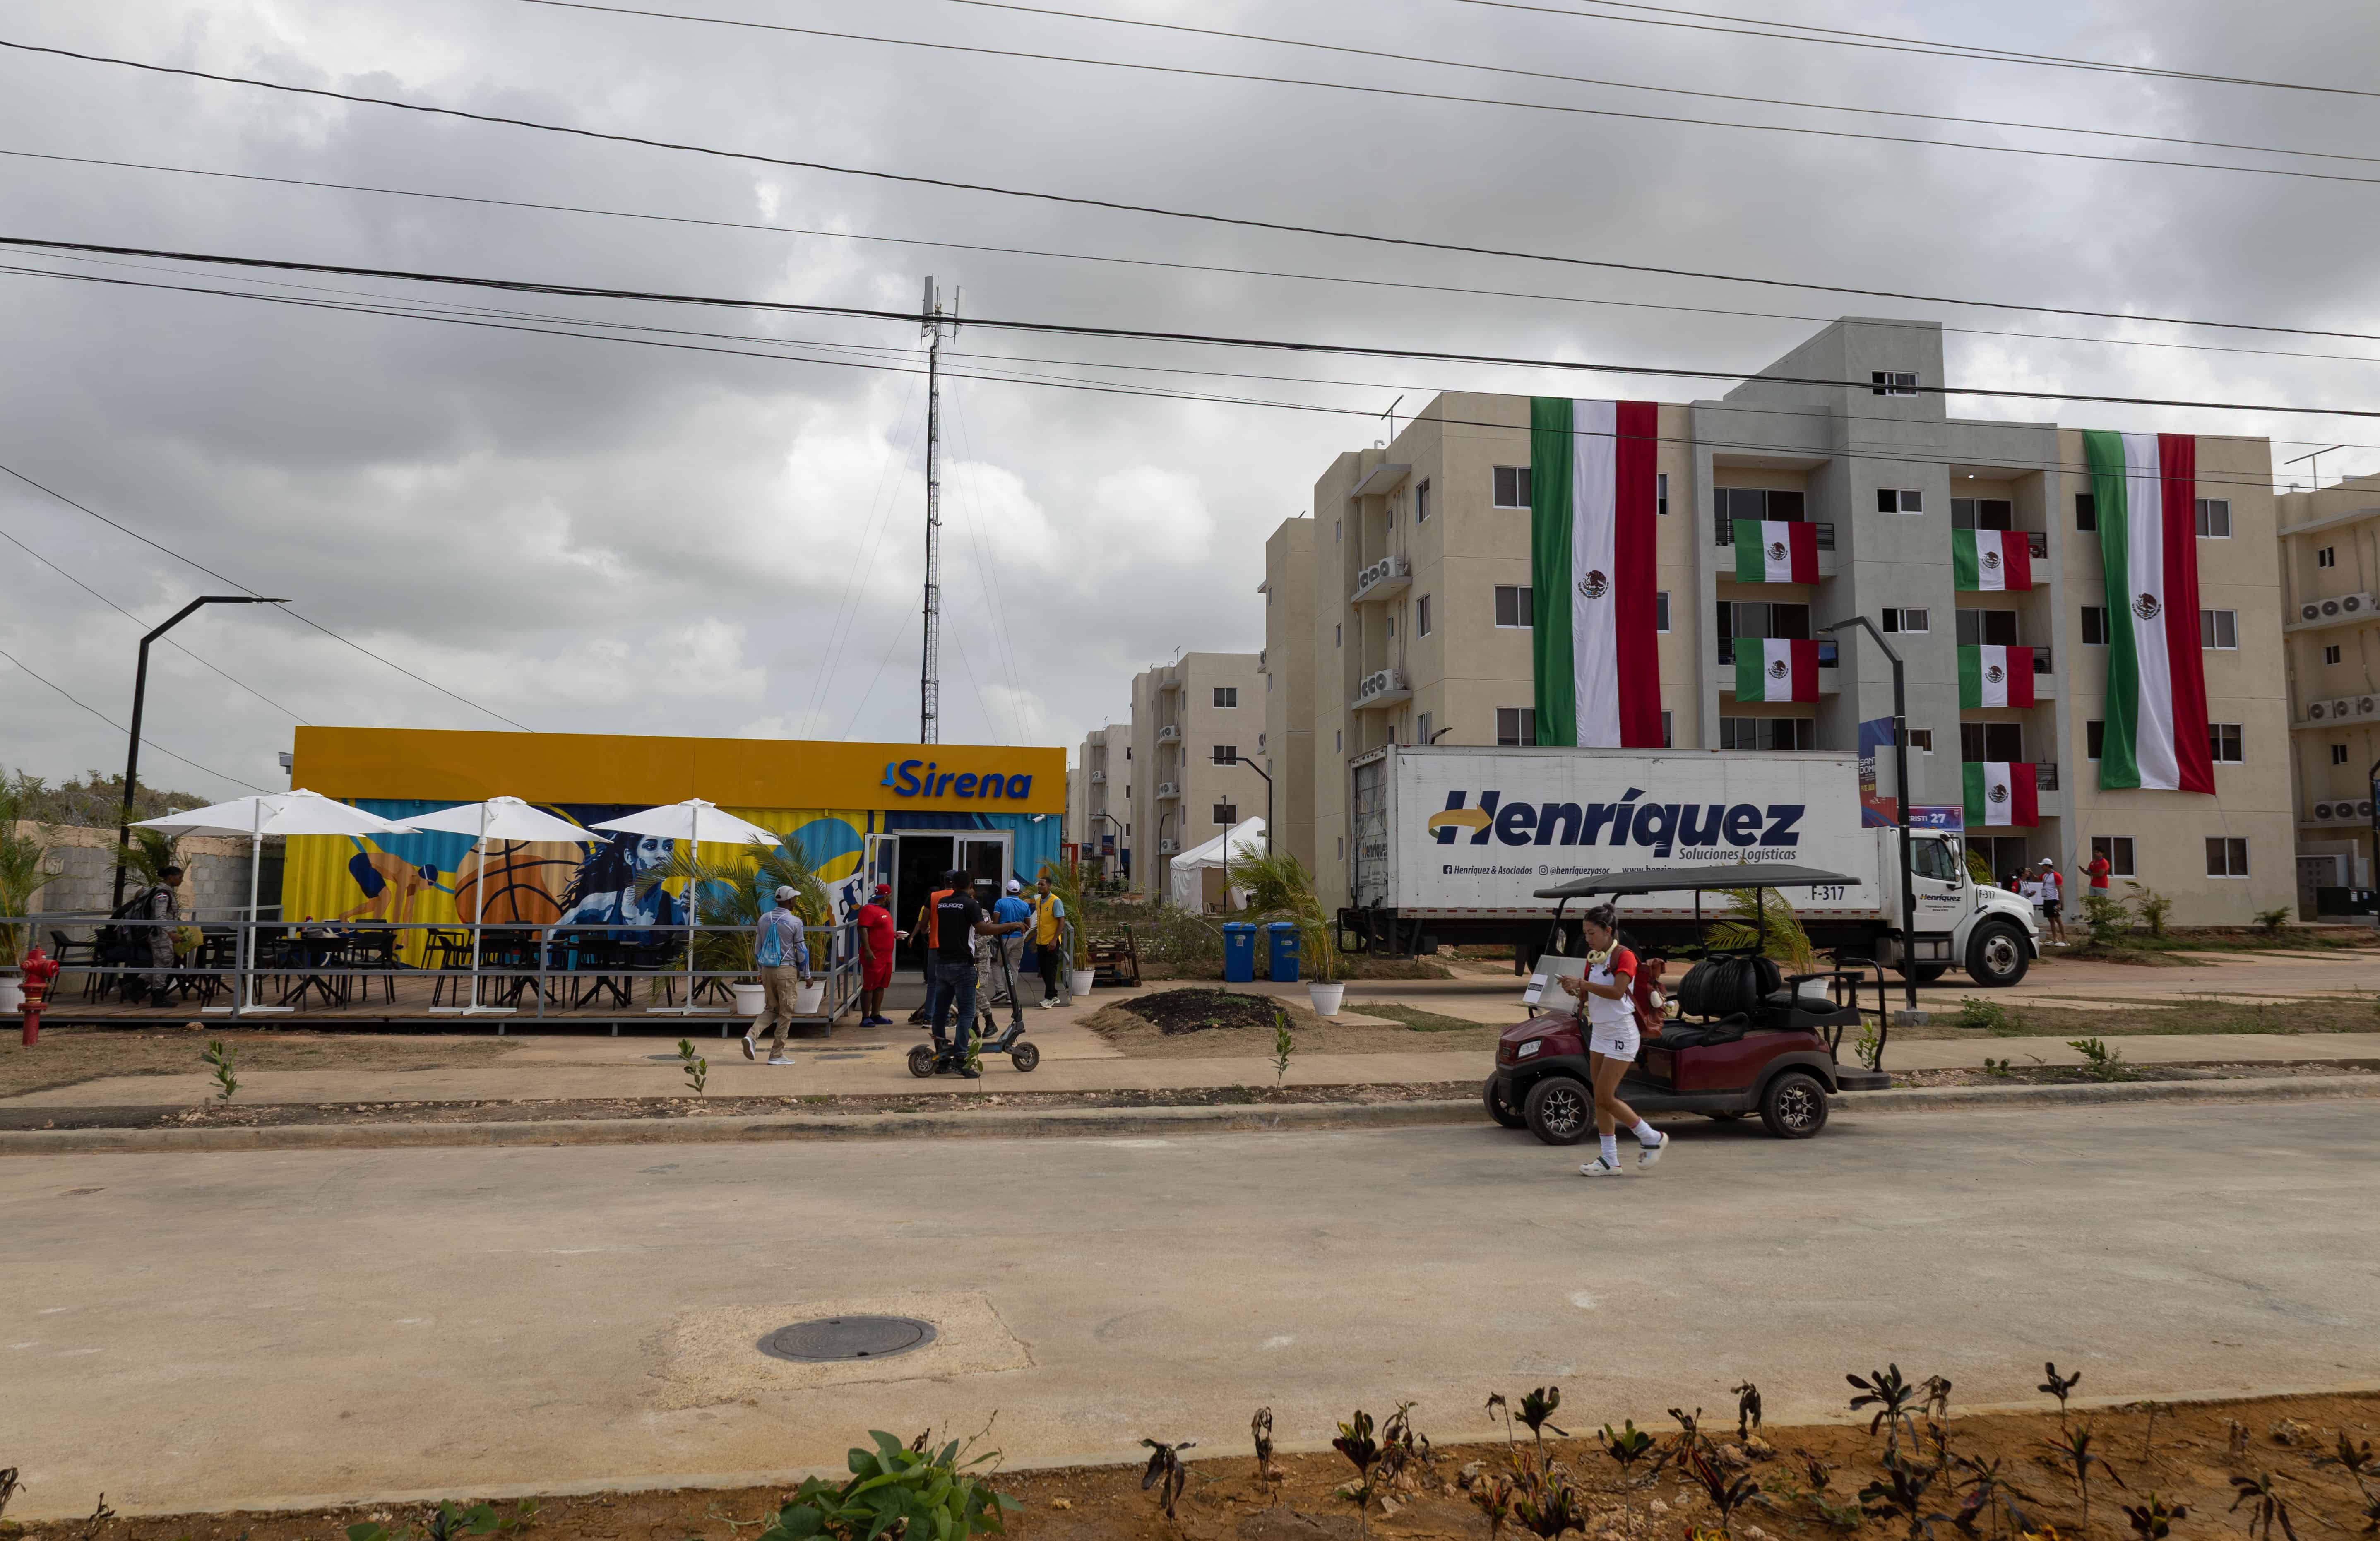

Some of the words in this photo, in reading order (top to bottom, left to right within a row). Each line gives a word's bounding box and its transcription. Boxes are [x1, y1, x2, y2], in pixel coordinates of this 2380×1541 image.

[1859, 757, 1875, 766] SANT
[1859, 765, 1875, 774] DOMI
[894, 759, 1033, 800] Sirena
[1435, 786, 1805, 858] Henríquez
[1930, 813, 1946, 823] 27
[1678, 847, 1739, 861] Soluciones
[1741, 847, 1797, 863] Logísticas
[1454, 865, 1490, 876] Henriquez
[1491, 865, 1497, 875] &
[1498, 865, 1533, 875] Asociados
[1811, 885, 1845, 901] F-317
[1920, 893, 1962, 902] Henríquez
[1979, 890, 1995, 899] F-317
[1614, 1039, 1625, 1050] 15
